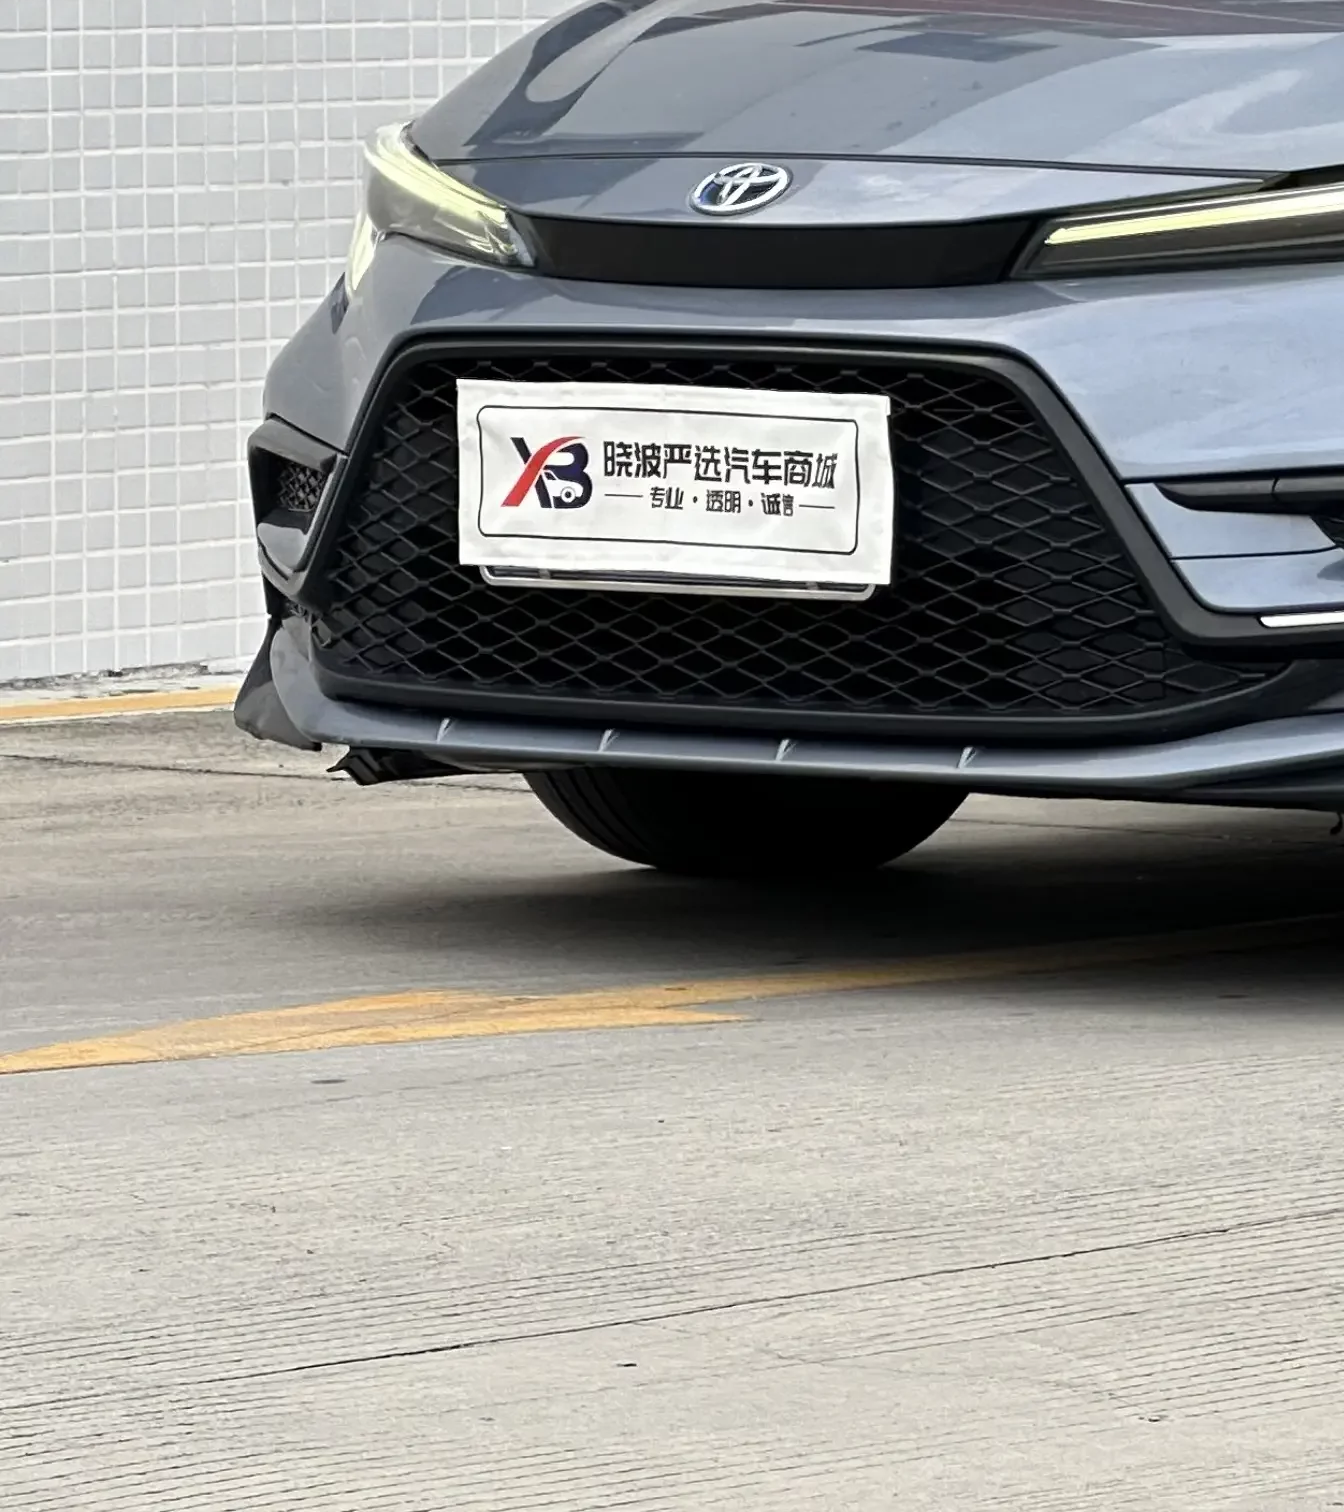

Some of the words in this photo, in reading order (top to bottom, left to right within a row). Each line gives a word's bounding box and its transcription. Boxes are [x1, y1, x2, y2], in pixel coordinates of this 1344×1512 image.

[603, 440, 840, 490] 晓波严选汽车商城
